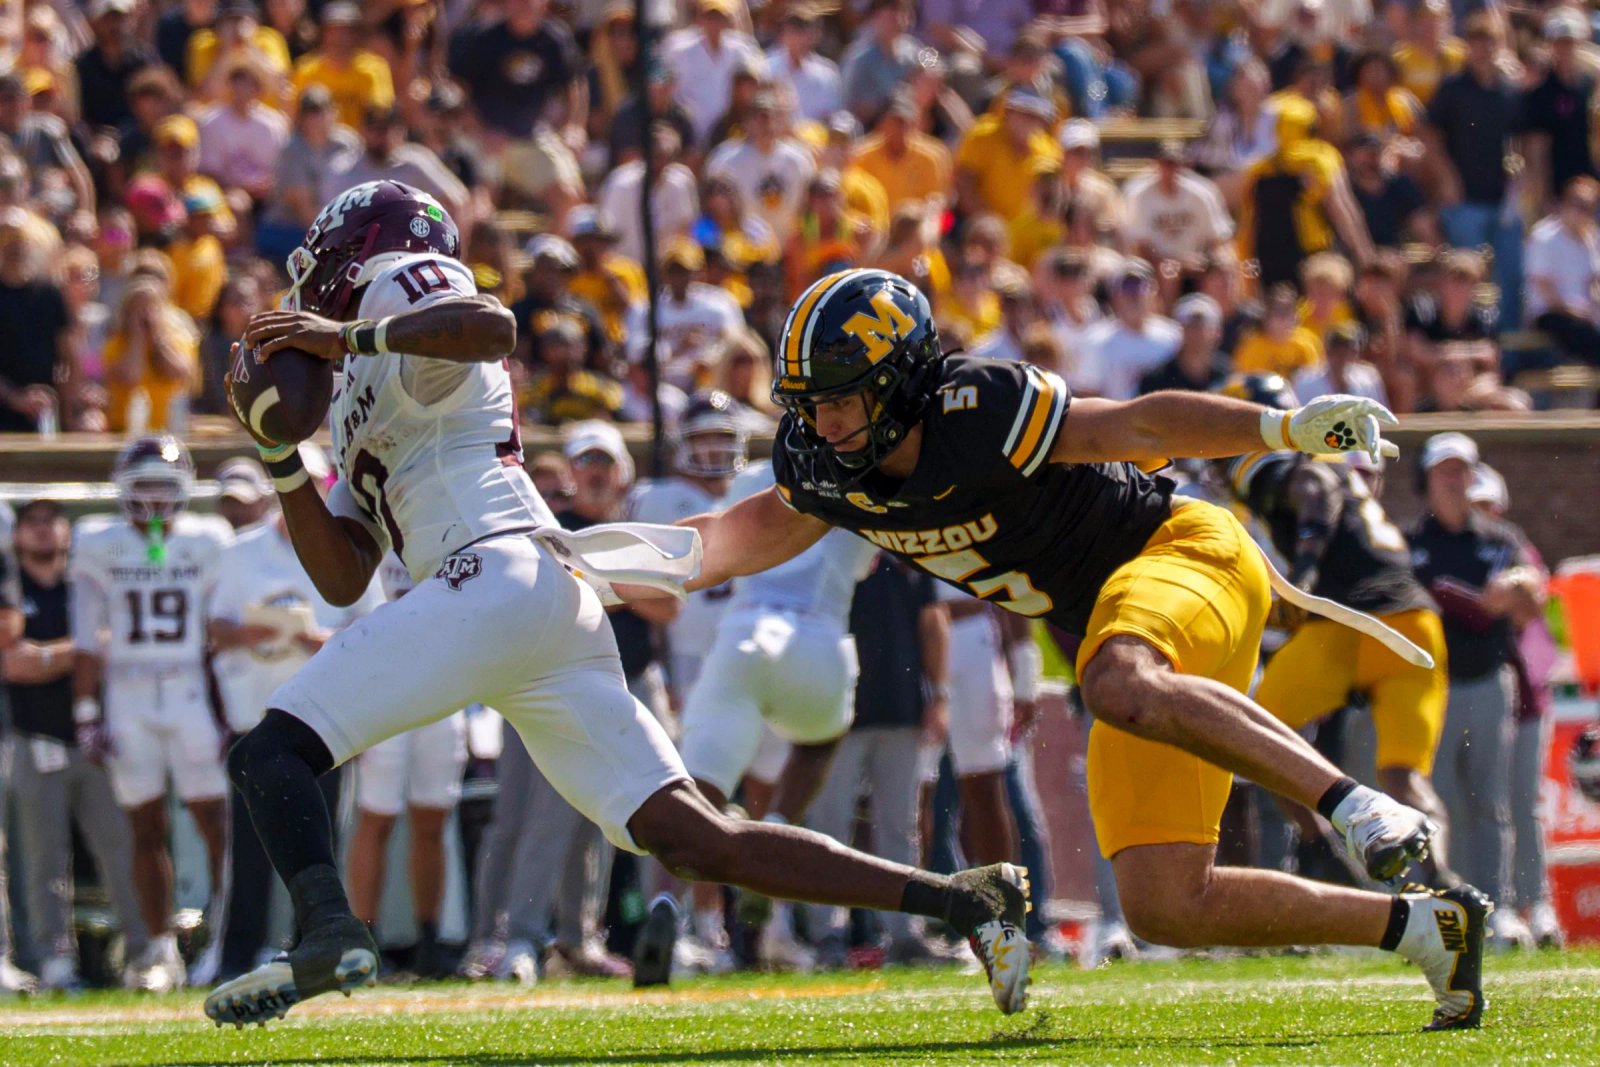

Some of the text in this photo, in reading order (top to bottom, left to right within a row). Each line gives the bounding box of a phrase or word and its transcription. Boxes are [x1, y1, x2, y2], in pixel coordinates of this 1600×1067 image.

[411, 218, 430, 236] SEC
[392, 259, 451, 306] 10
[841, 289, 917, 366] M
[943, 385, 978, 415] 5
[859, 513, 998, 555] MIZZOU
[912, 548, 1054, 618] 5
[125, 588, 188, 643] 19
[1433, 909, 1468, 952] NIKE
